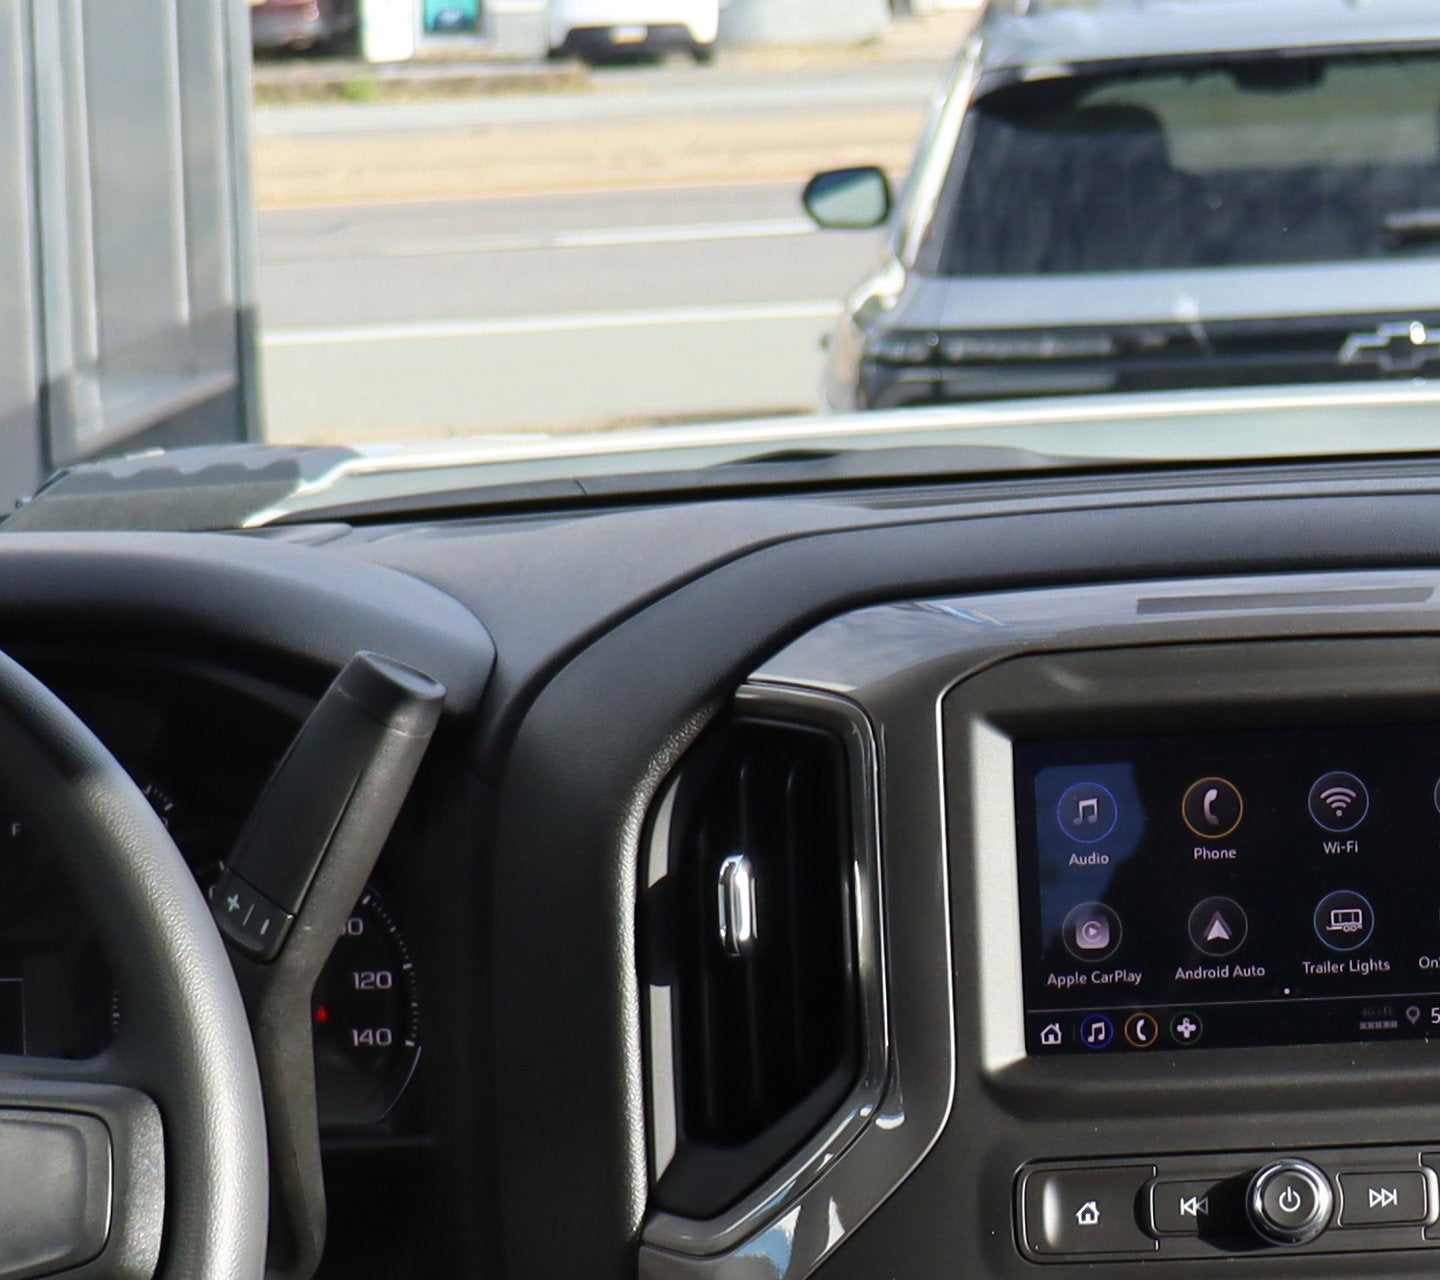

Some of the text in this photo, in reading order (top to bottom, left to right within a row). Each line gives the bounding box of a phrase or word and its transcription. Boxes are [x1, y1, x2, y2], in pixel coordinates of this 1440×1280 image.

[10, 823, 21, 838] F
[1192, 846, 1238, 861] Phone
[1322, 840, 1359, 855] Wi-Fi
[1068, 851, 1110, 867] Audio
[1174, 964, 1267, 981] Android Auto
[1302, 958, 1392, 976] Trailer Lights
[352, 971, 393, 990] 120
[1047, 969, 1143, 989] Apple CarPlay
[351, 1027, 393, 1047] 140
